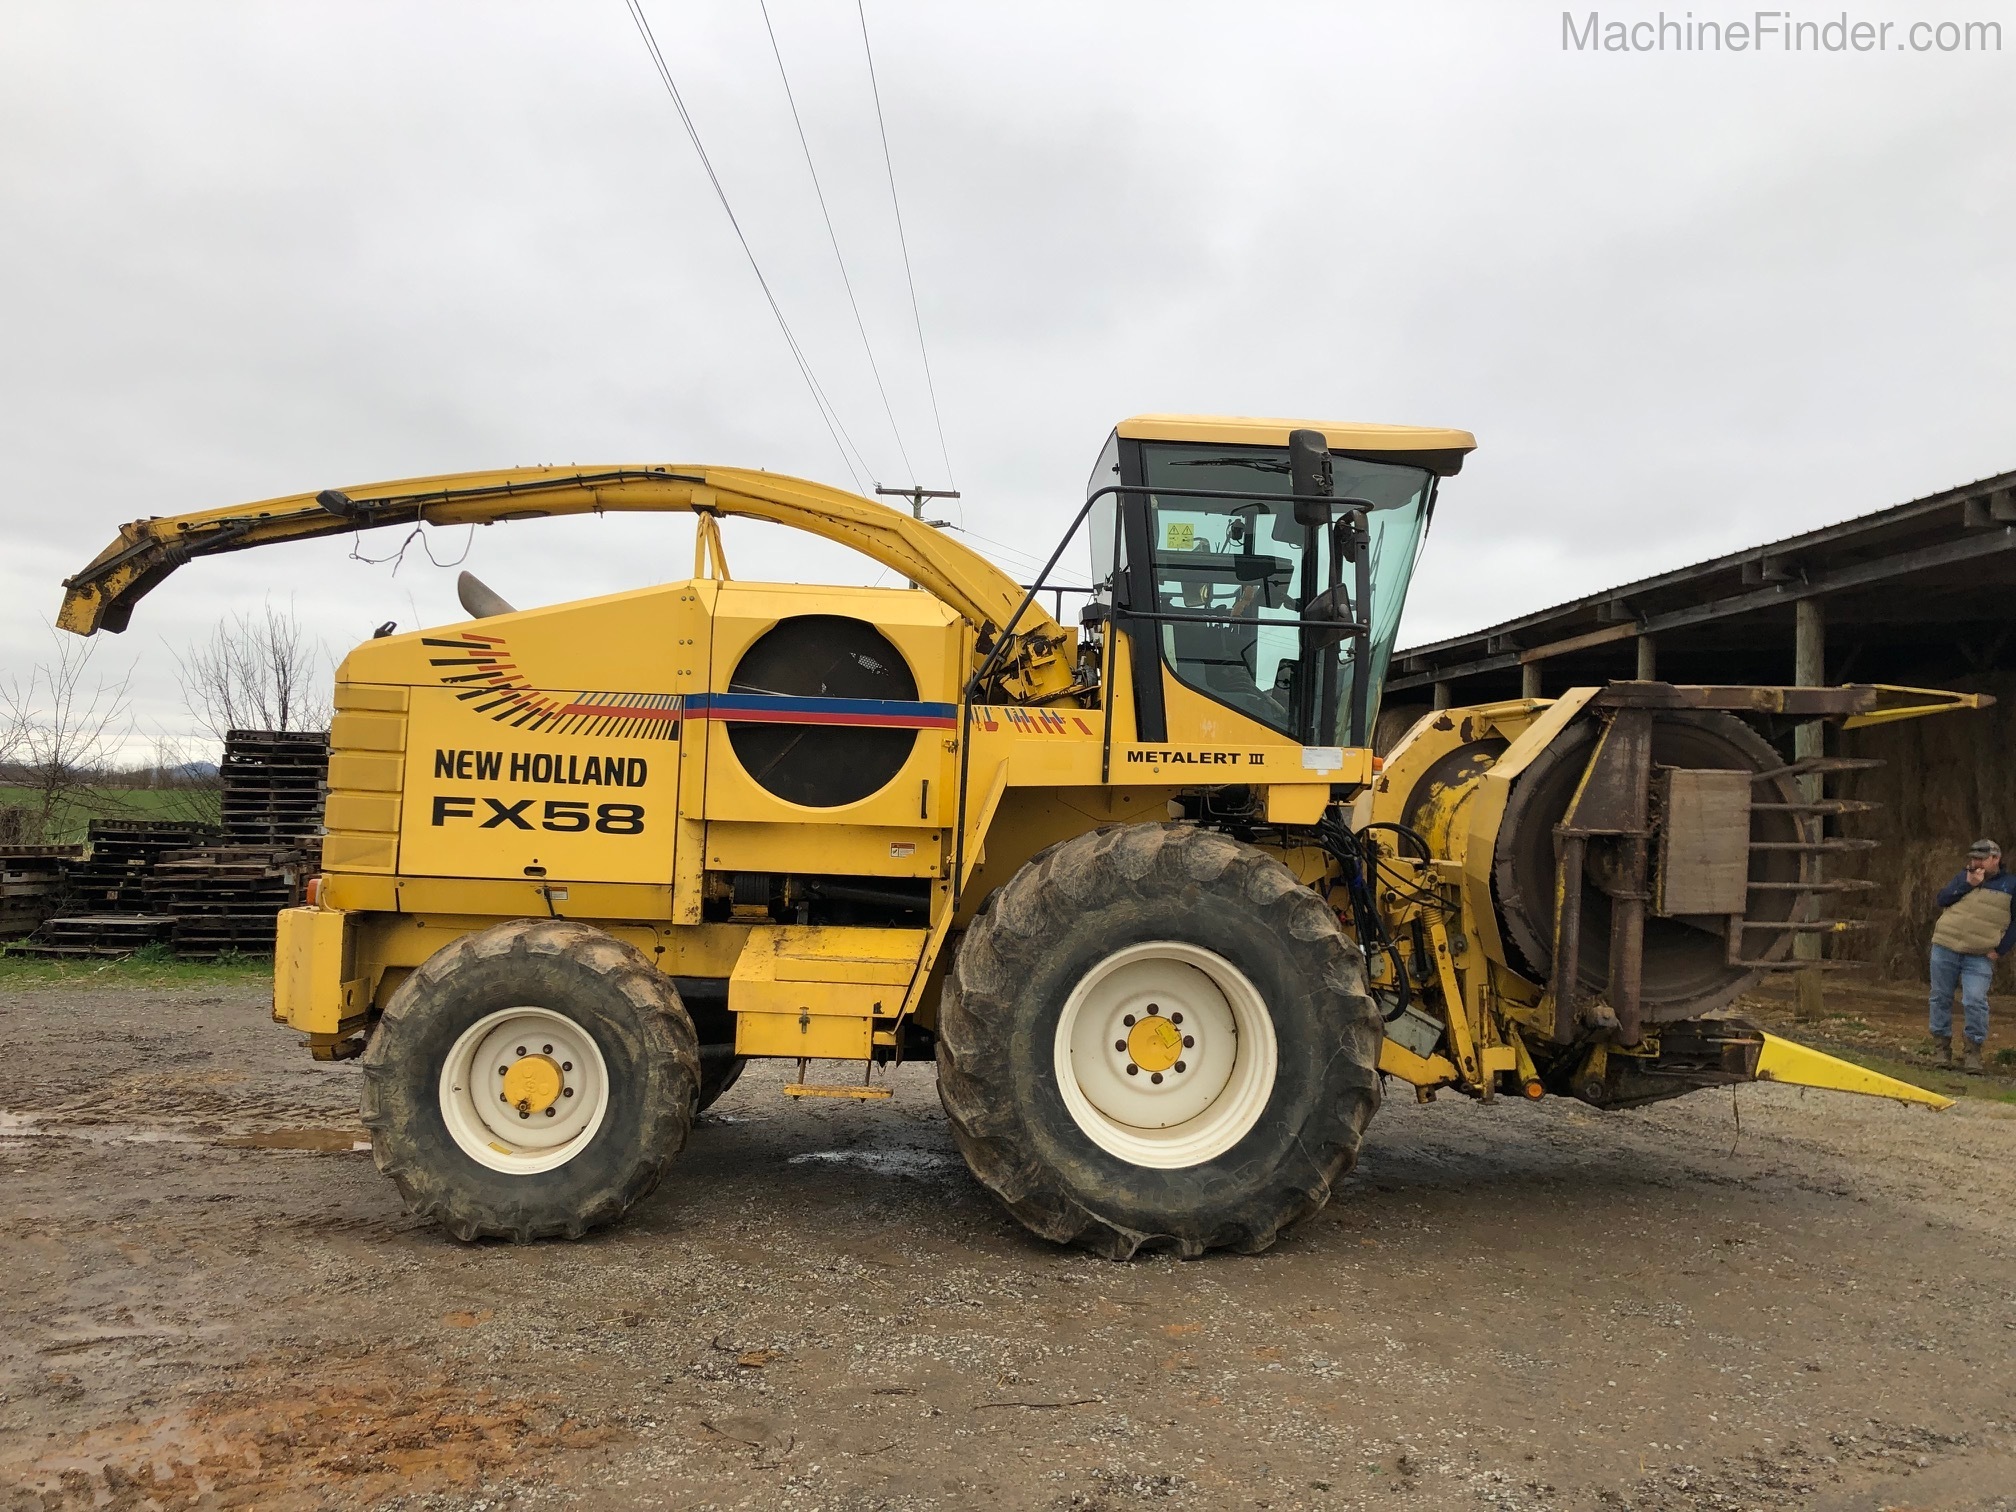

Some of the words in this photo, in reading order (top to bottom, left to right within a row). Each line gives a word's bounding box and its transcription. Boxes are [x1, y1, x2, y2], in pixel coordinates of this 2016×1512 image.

[434, 749, 503, 781] NEW
[509, 752, 648, 788] HOLLAND
[1127, 750, 1241, 765] METALERT
[1248, 753, 1265, 765] III
[431, 796, 645, 835] FX58
